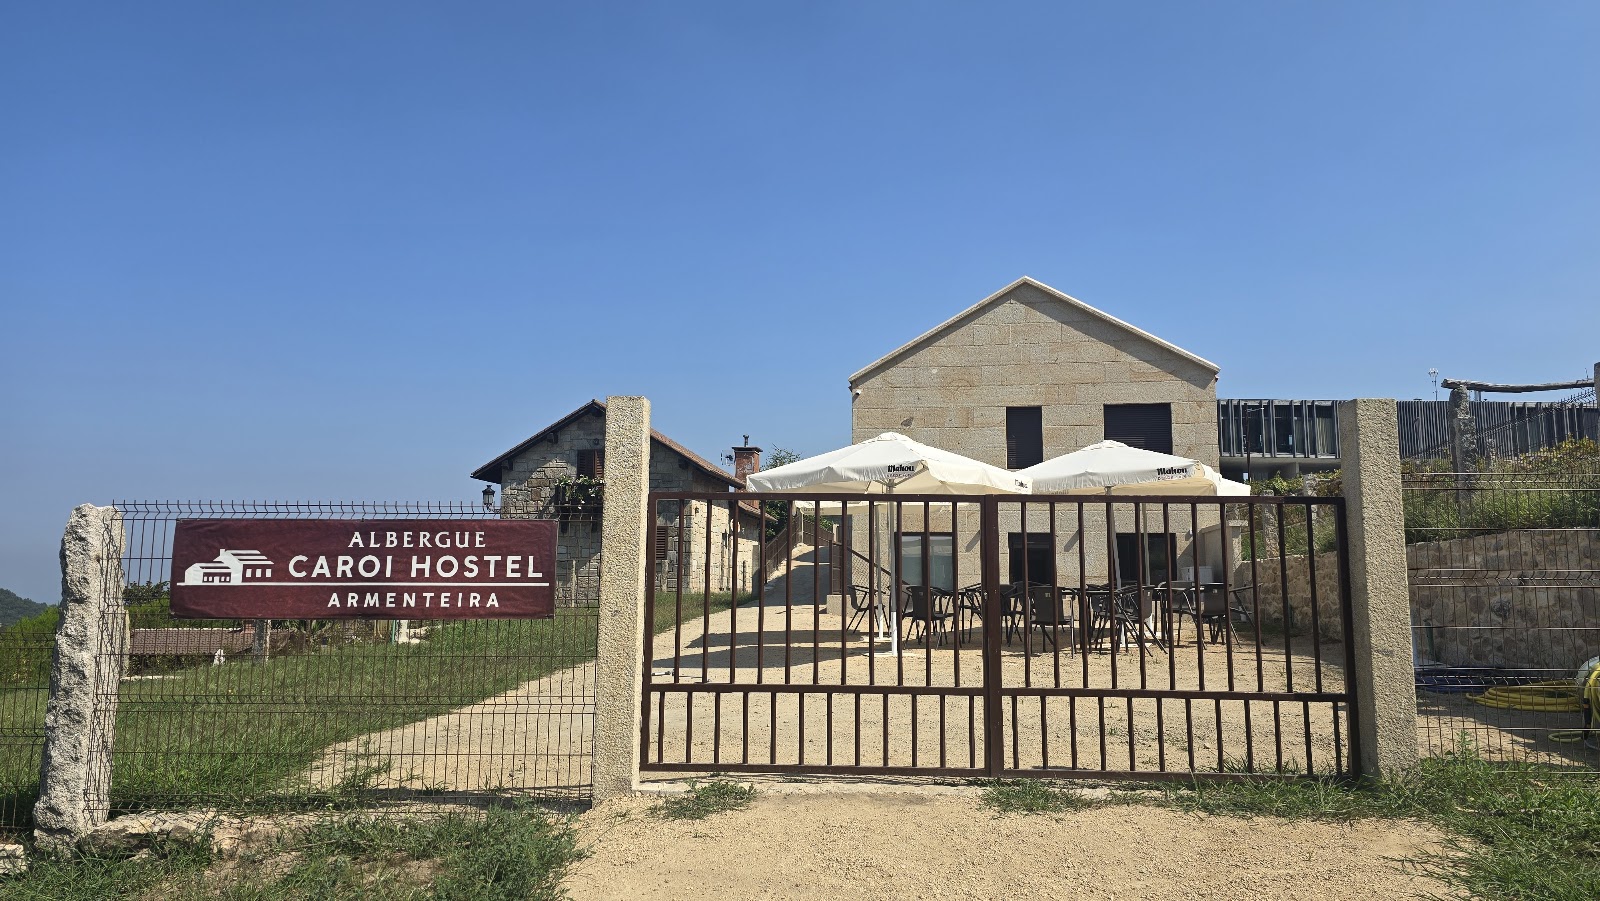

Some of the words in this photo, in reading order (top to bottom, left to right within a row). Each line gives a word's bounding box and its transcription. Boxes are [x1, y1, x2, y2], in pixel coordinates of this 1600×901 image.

[887, 464, 915, 473] Mahou
[348, 531, 486, 548] ALBERGUE
[288, 555, 393, 578] CAROI
[410, 555, 543, 578] HOSTEL
[327, 592, 500, 608] ARMENTEIRA
